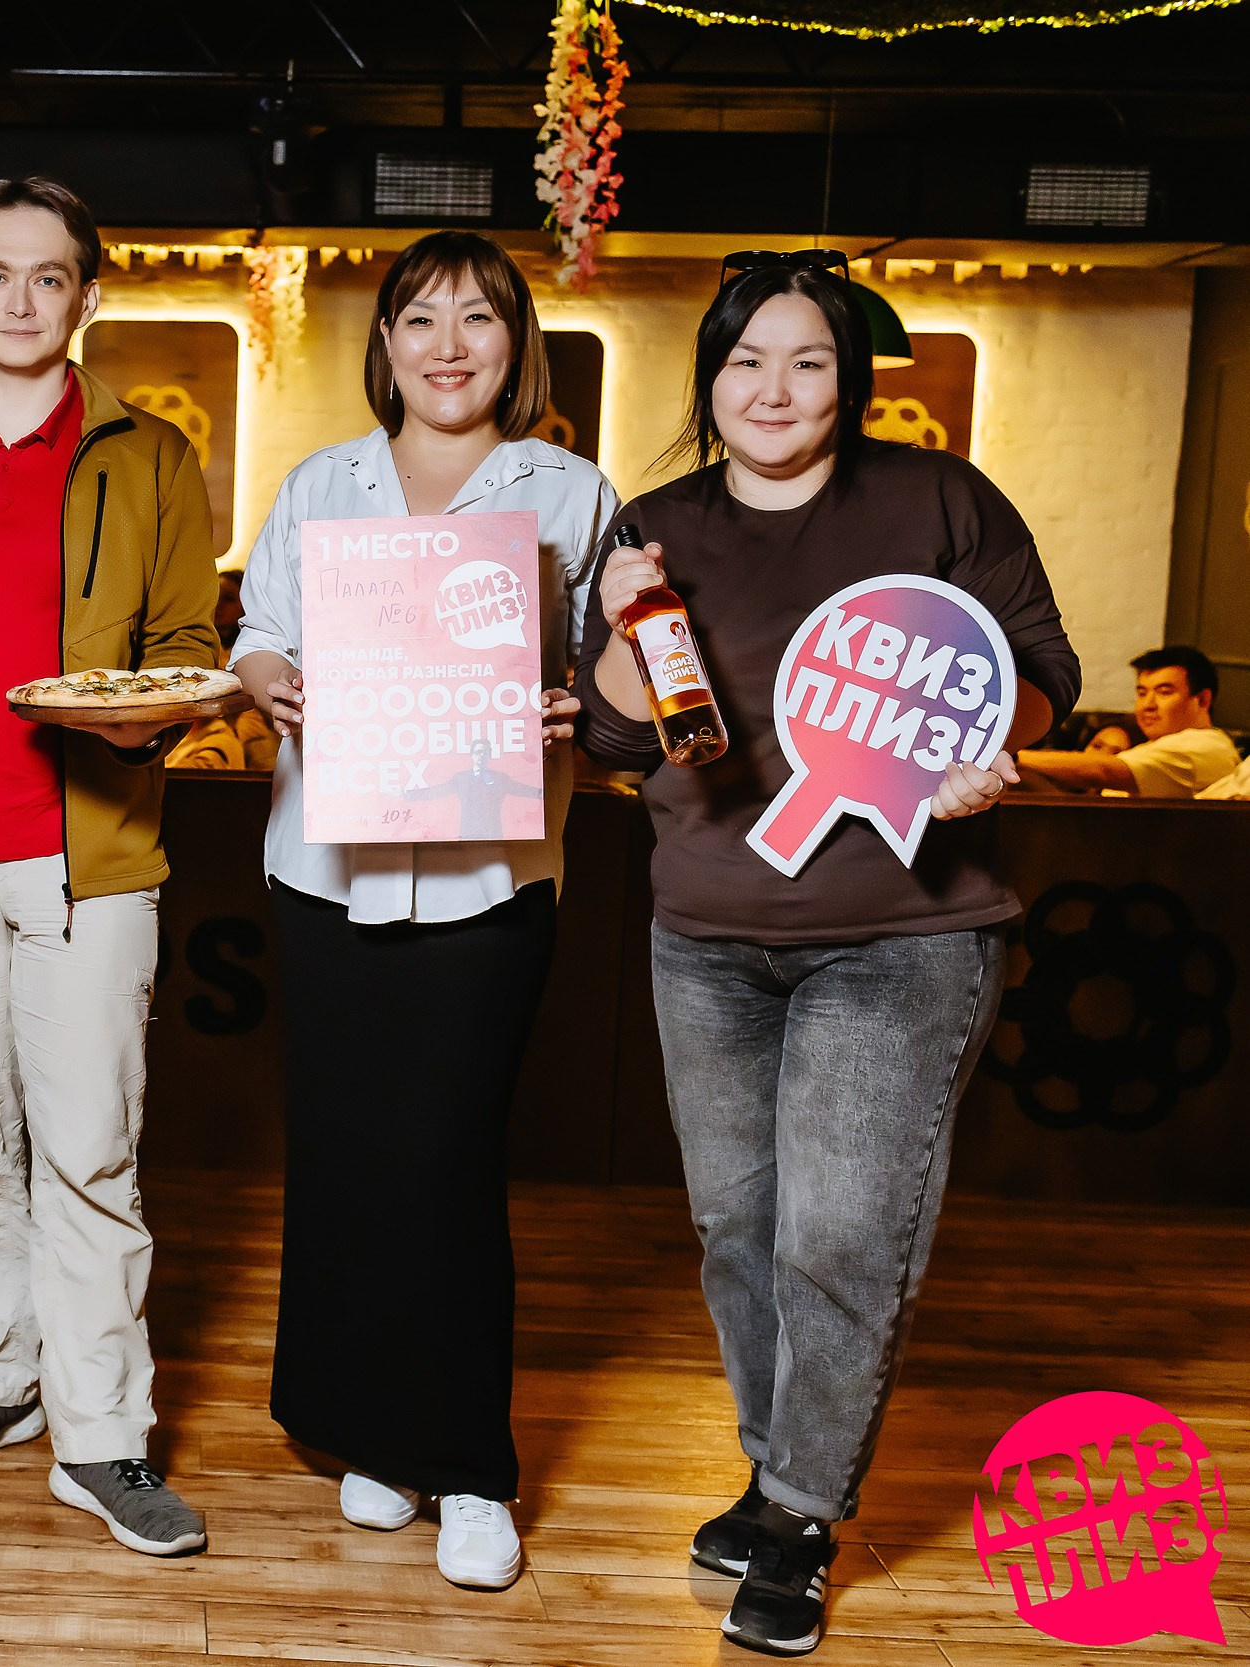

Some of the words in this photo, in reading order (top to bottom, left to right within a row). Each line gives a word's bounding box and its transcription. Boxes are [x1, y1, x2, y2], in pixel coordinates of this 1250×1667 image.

[317, 536, 329, 561] 1
[342, 530, 460, 561] МЕСТО
[439, 593, 528, 638] ПЛИЗ!
[316, 647, 409, 664] КОМАНДЕ,
[316, 666, 400, 682] КОТОРАЯ
[402, 663, 496, 680] РАЗНЕСЛА
[812, 607, 1002, 730] КВИЗ,
[316, 759, 431, 794] ВСЕХ
[157, 916, 267, 1036] S
